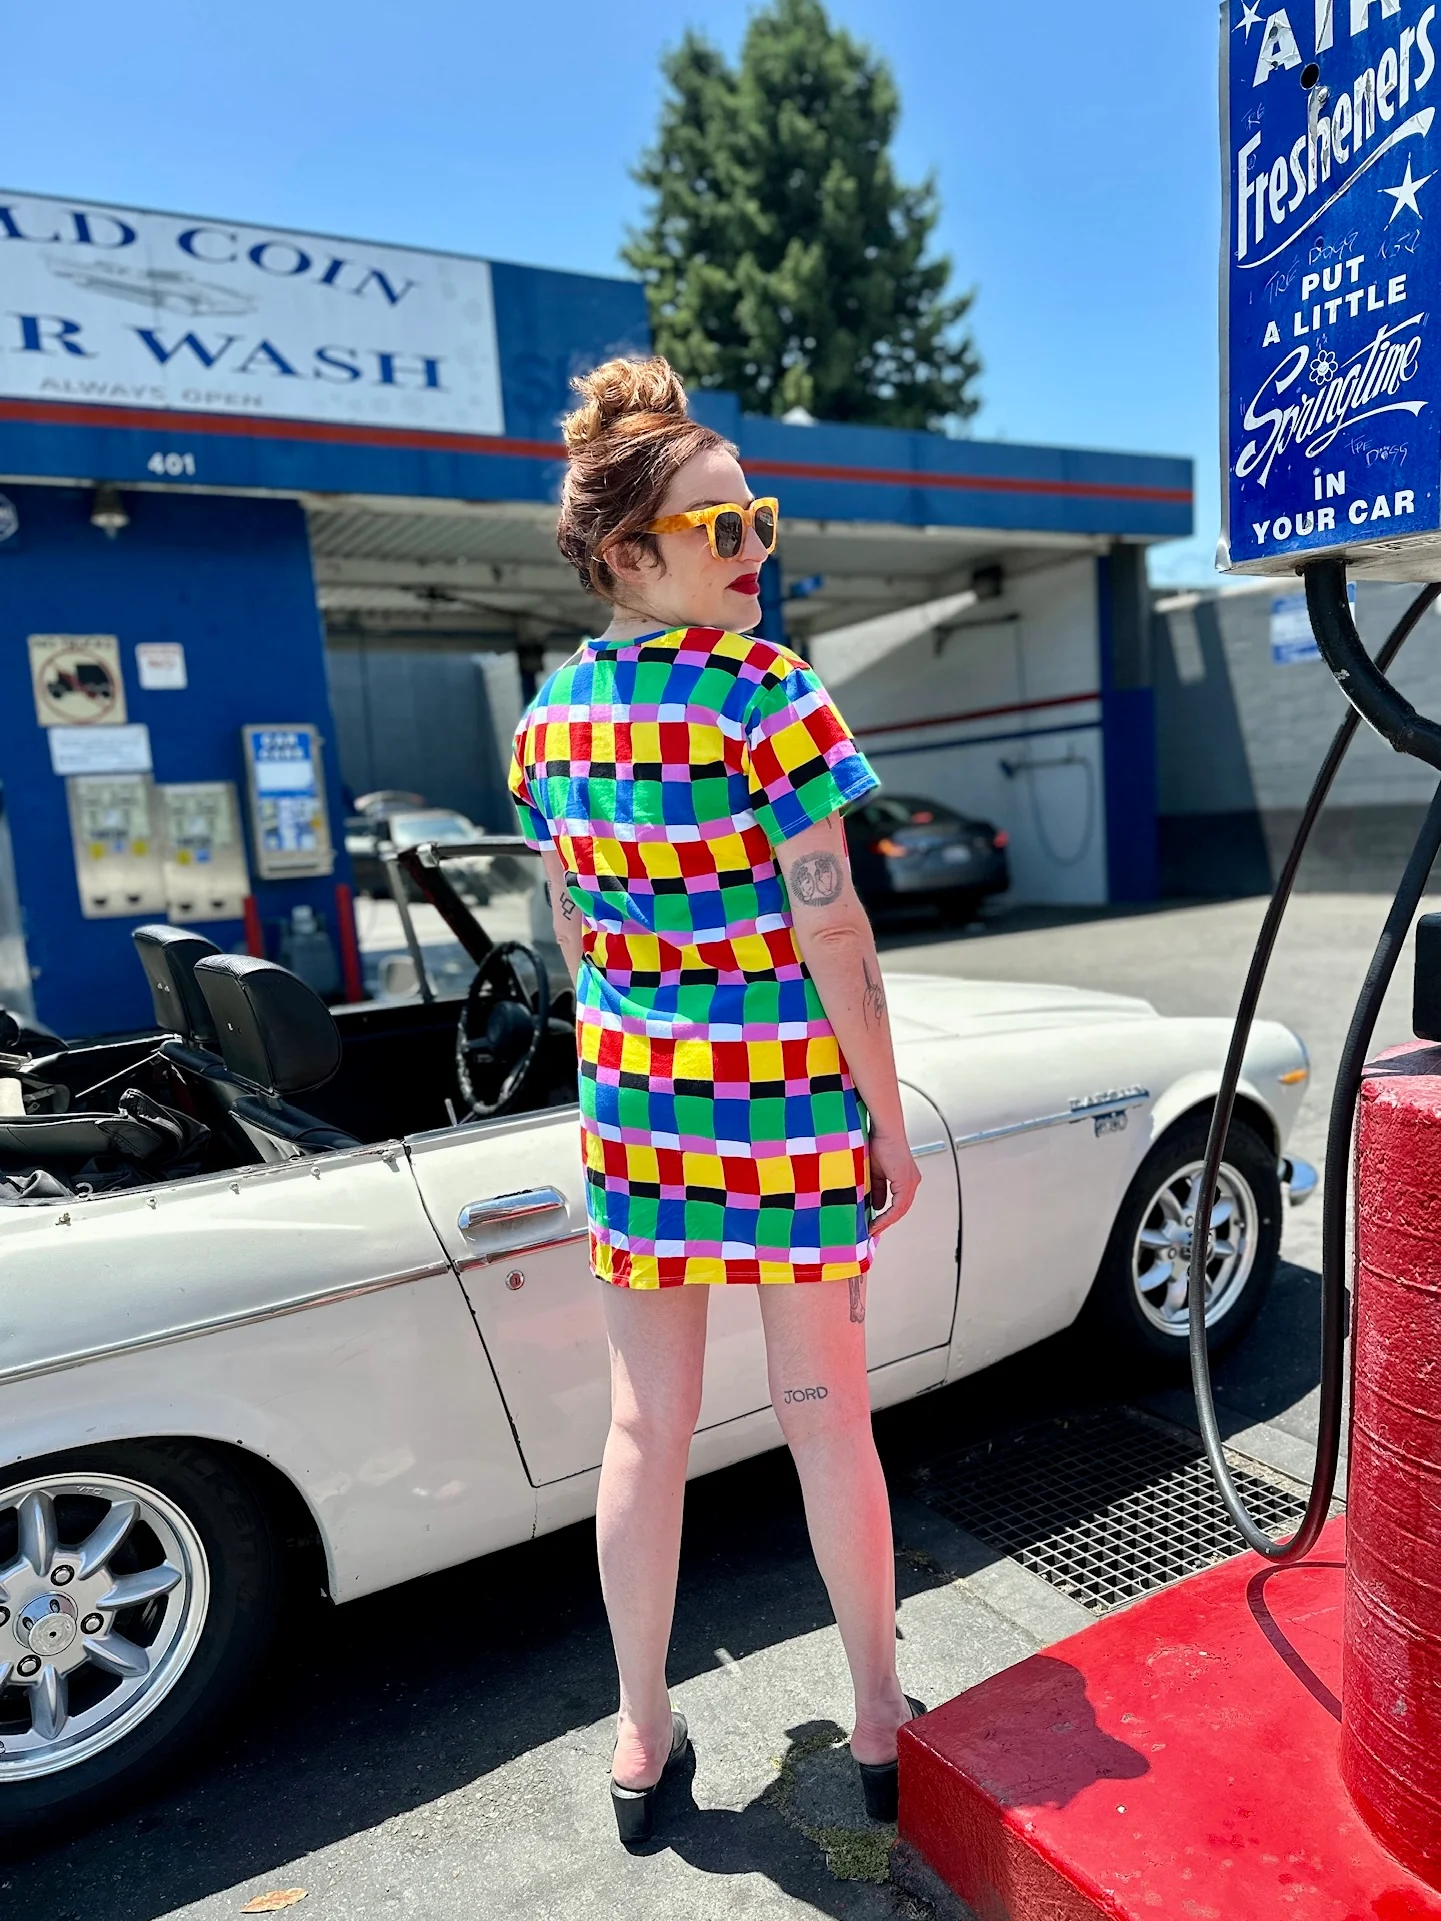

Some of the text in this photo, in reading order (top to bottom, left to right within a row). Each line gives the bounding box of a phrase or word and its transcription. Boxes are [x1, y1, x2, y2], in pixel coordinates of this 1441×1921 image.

[1238, 5, 1436, 261] Fresheners
[176, 225, 421, 307] COIN
[1301, 255, 1365, 301] PUT
[1262, 274, 1407, 347] A LITTLE
[122, 322, 451, 393] WASH
[40, 377, 263, 407] ALWAYS OPEN
[1235, 312, 1428, 488] Springtime
[147, 452, 196, 476] 401
[1252, 507, 1335, 544] YOUR
[1348, 490, 1415, 525] CAR
[784, 1387, 828, 1404] JORD
